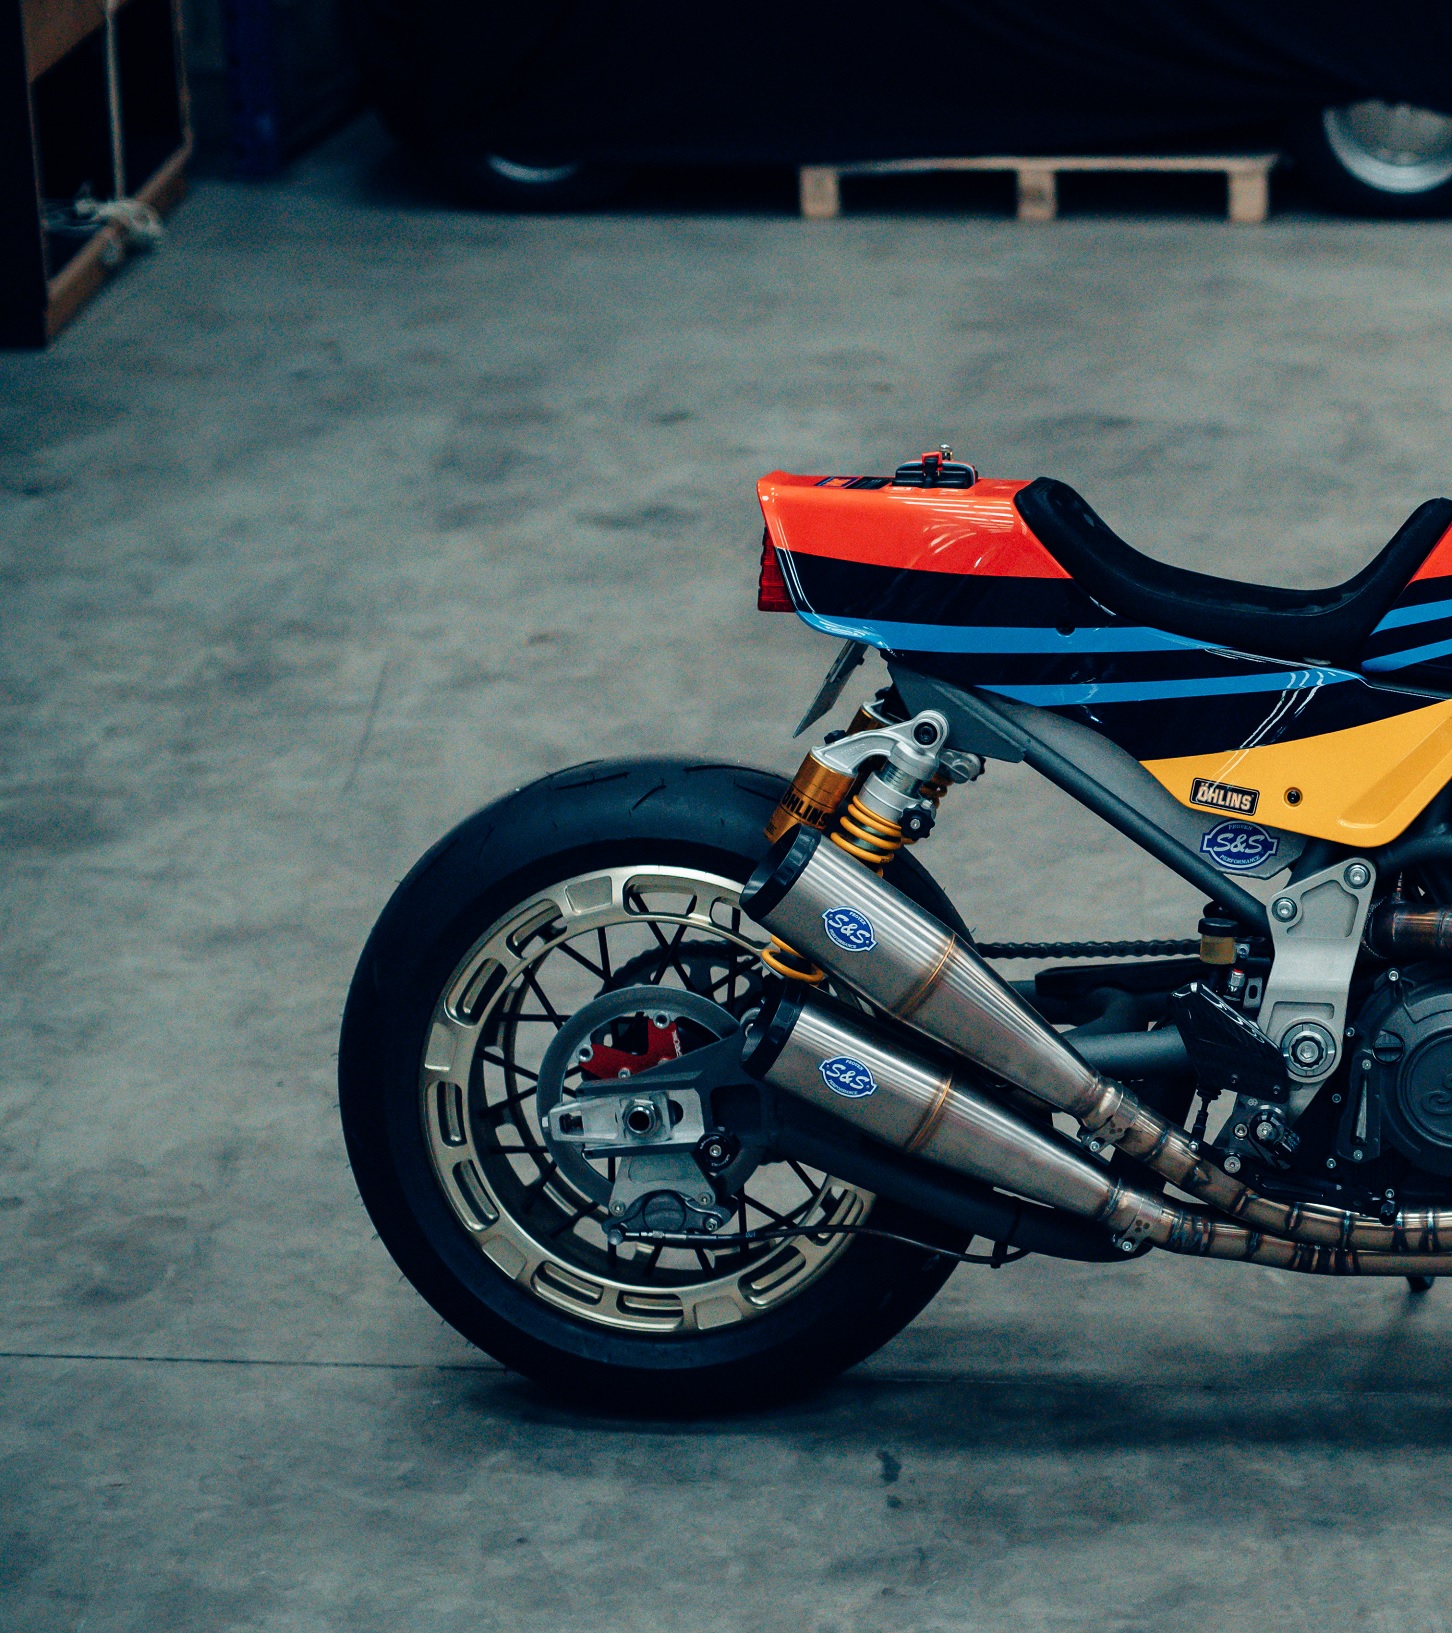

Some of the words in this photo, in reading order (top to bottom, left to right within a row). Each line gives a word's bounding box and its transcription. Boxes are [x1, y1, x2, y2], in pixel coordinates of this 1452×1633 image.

[1197, 782, 1252, 811] ÖHLINS
[1213, 833, 1265, 854] S&S
[1220, 854, 1261, 865] PERFORMANCE
[828, 914, 871, 944] S&S
[826, 1063, 870, 1090] S&S
